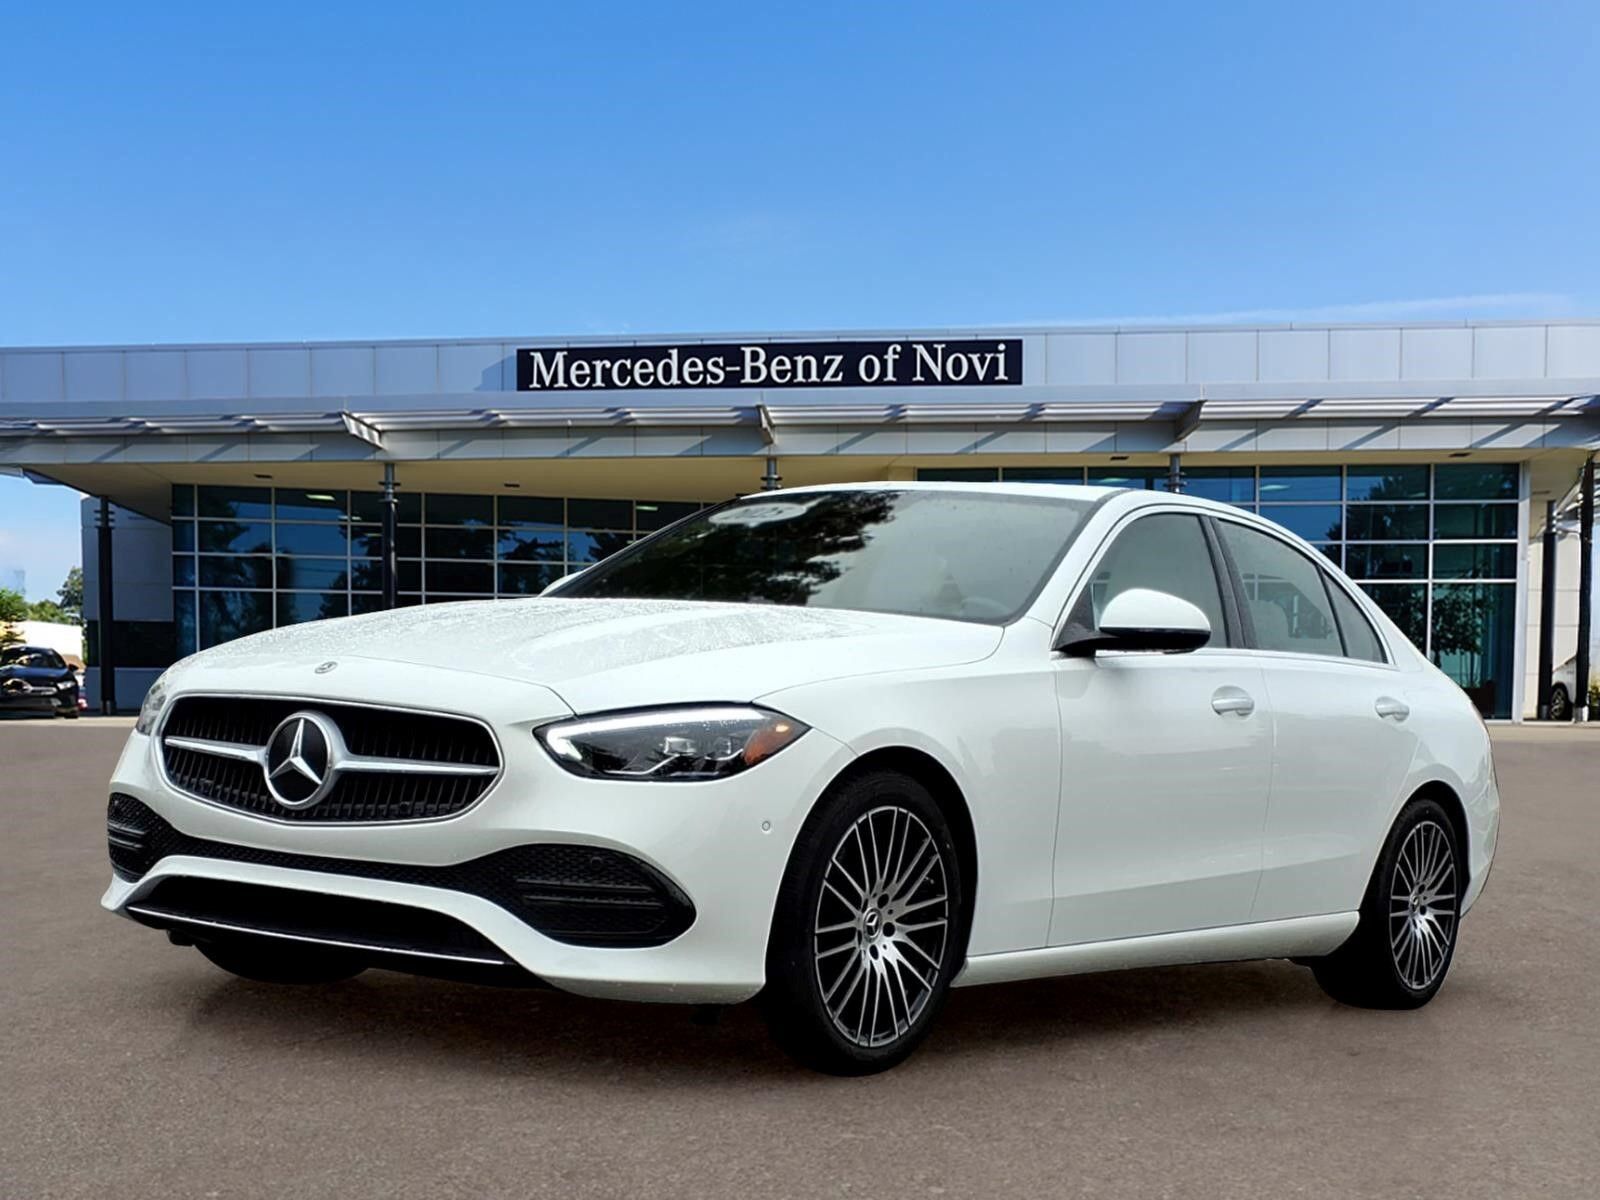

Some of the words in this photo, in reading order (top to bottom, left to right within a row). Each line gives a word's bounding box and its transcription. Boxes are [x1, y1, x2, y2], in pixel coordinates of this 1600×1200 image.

[529, 346, 844, 389] Mercedes-Benz
[858, 343, 902, 383] of
[912, 343, 1009, 382] Novi
